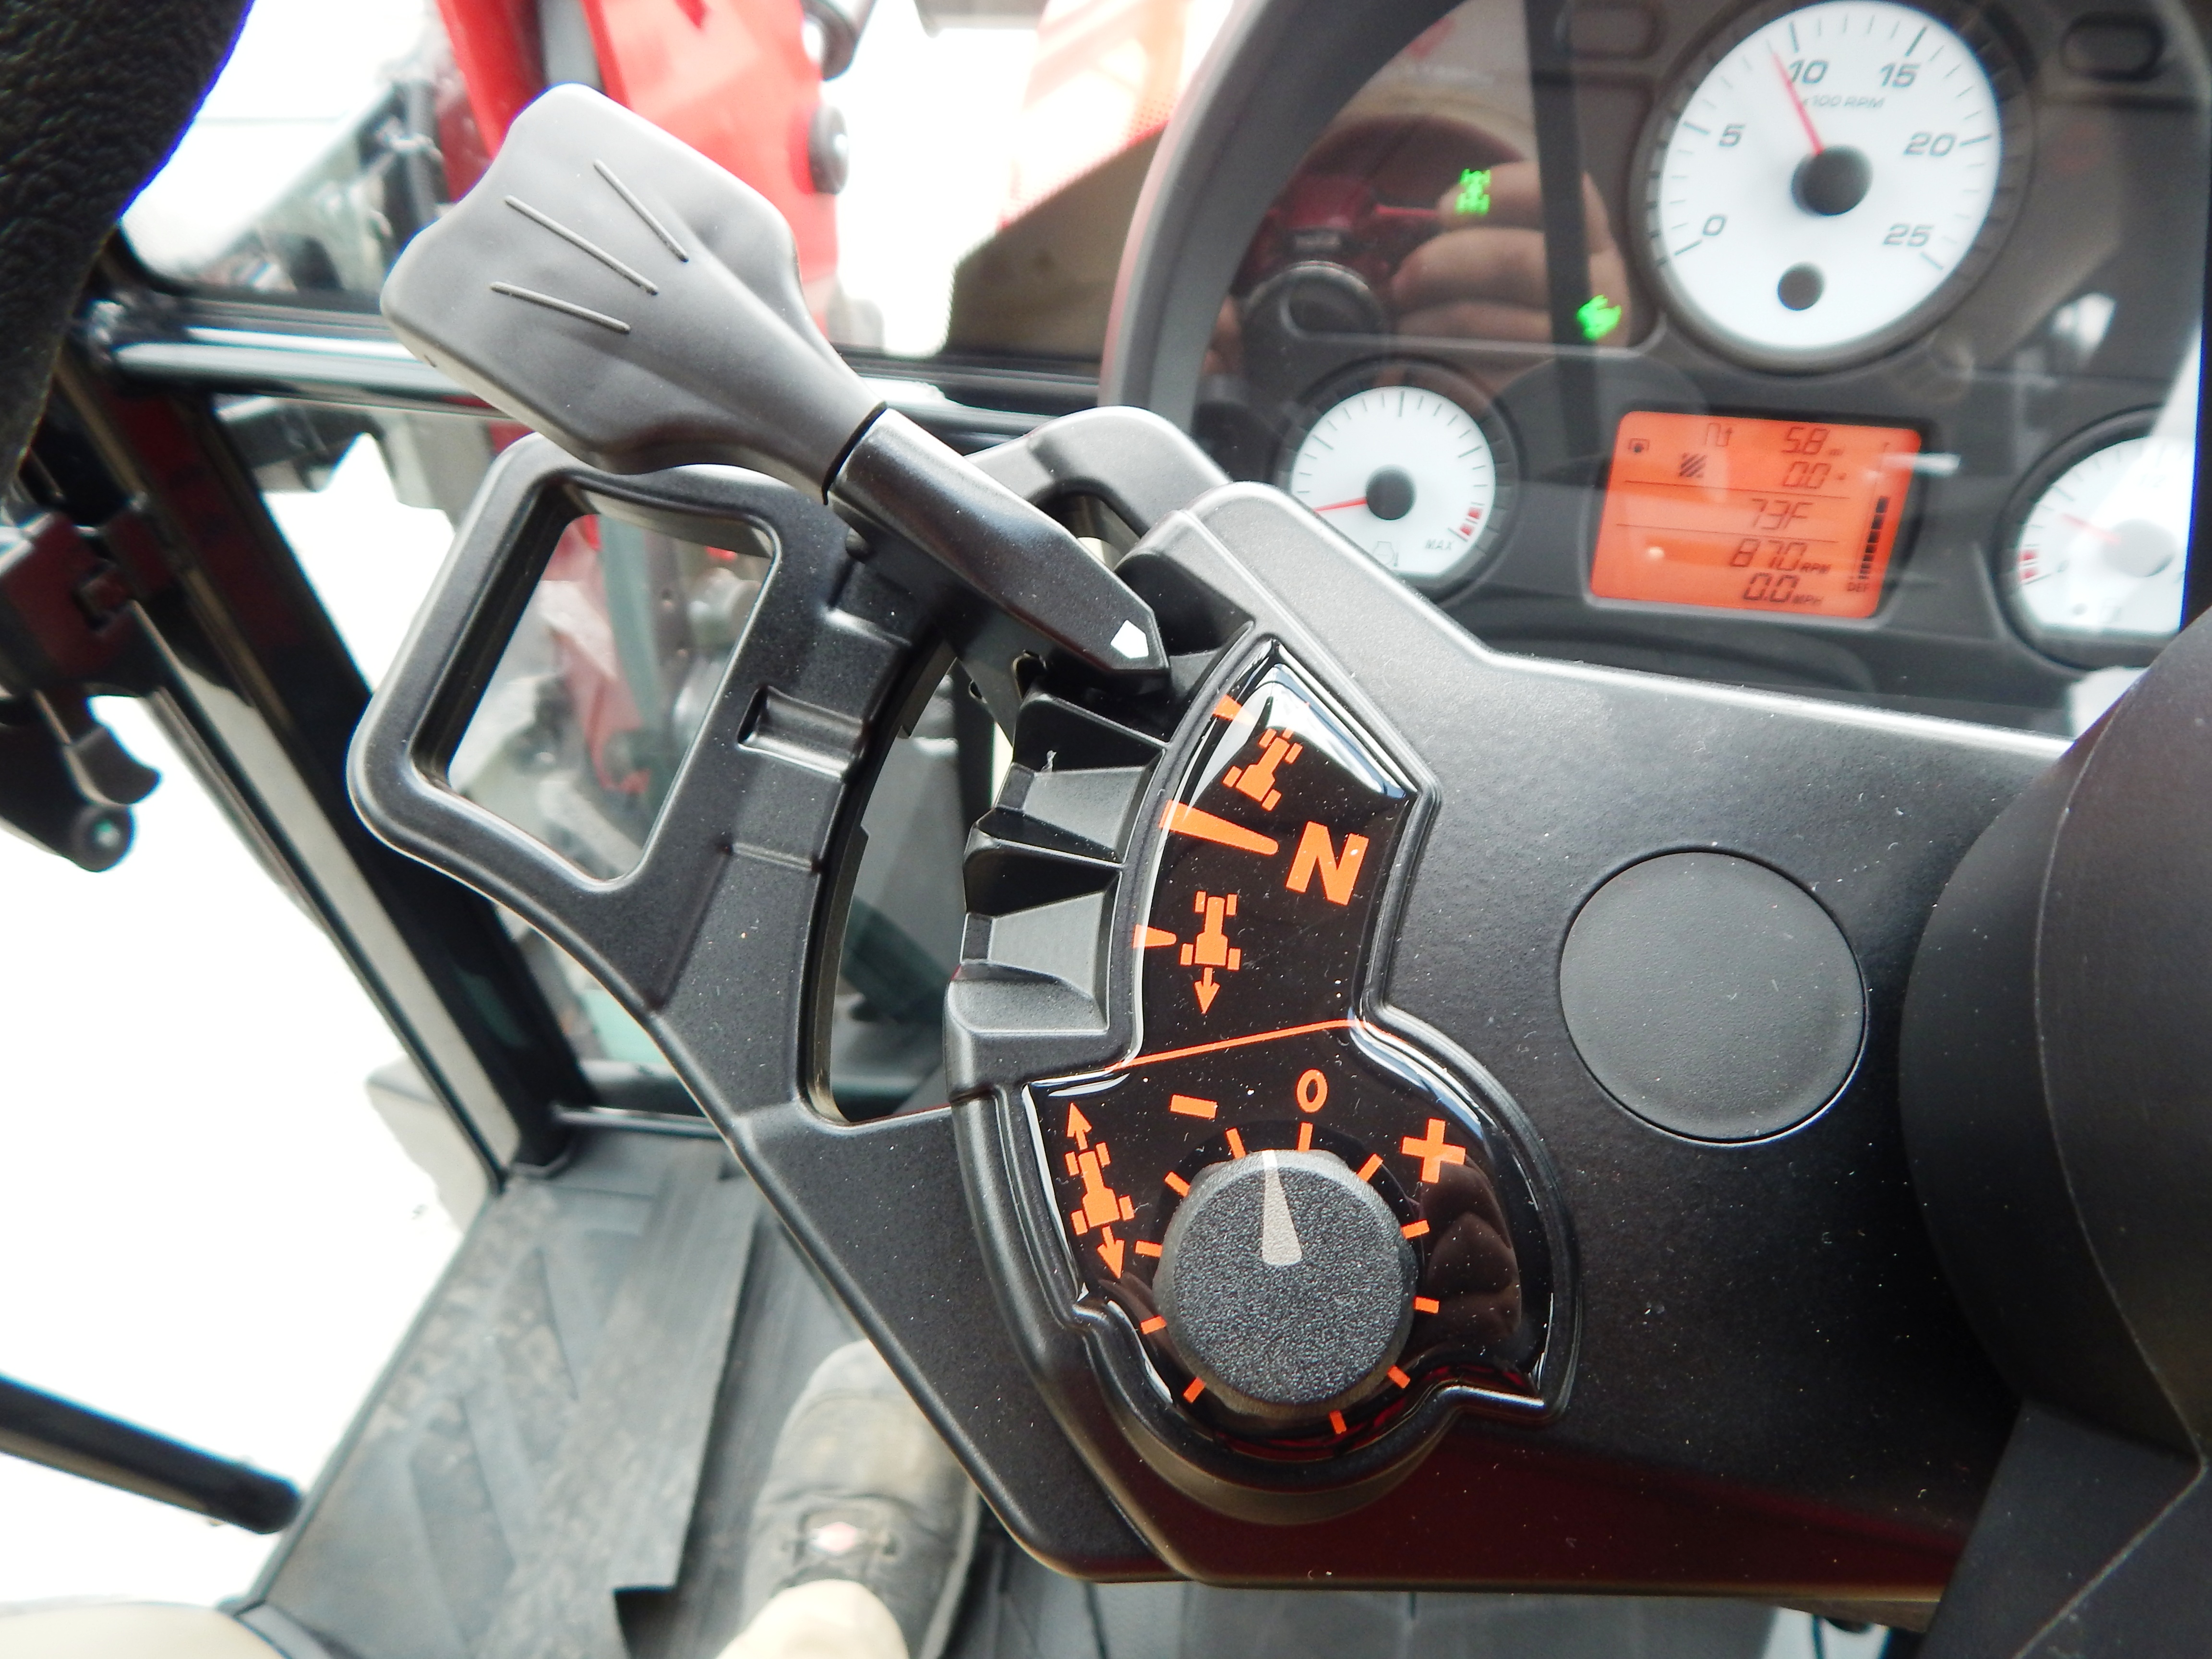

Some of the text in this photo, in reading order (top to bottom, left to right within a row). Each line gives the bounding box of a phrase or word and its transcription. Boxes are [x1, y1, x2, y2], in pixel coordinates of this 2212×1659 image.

[1789, 60, 1828, 84] 10
[1879, 63, 1922, 88] 15
[1843, 96, 1885, 108] RPM
[1719, 123, 1745, 147] 5
[1903, 131, 1956, 157] 20
[1702, 214, 1727, 237] 0
[1882, 224, 1934, 248] 25
[1425, 539, 1455, 550] MAX
[1729, 538, 1808, 571] 870
[1847, 582, 1870, 592] DEF
[1286, 821, 1369, 905] N
[1296, 1070, 1328, 1113] 0
